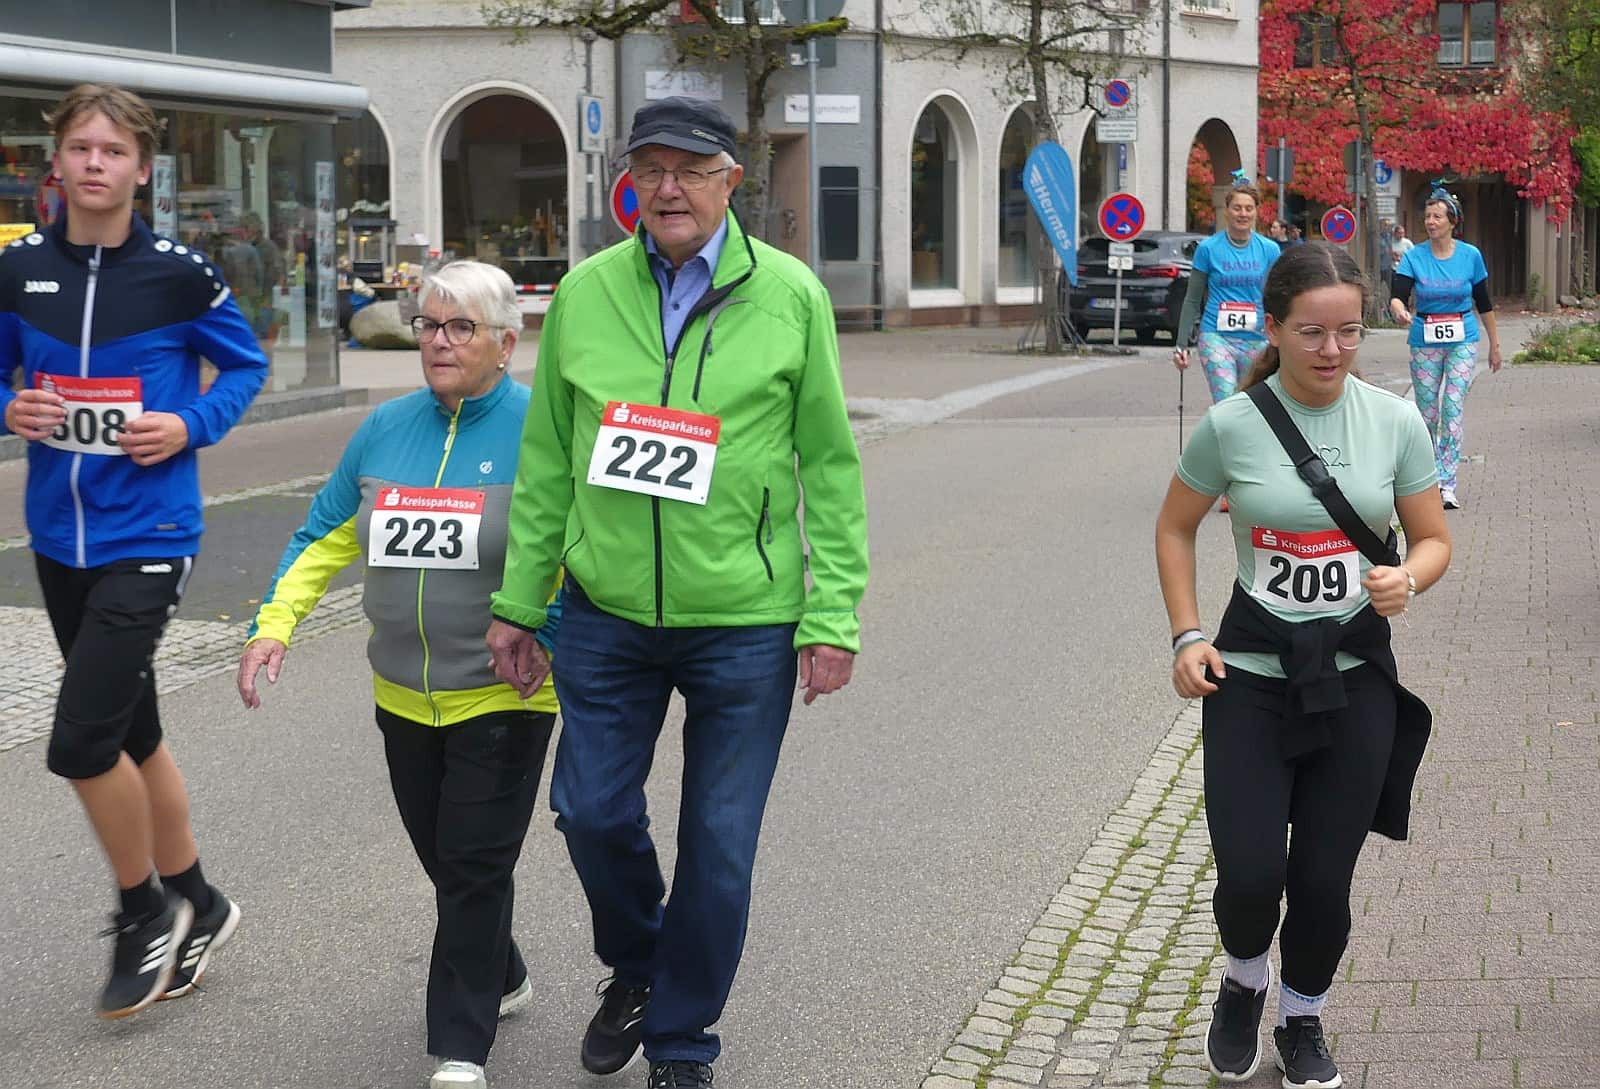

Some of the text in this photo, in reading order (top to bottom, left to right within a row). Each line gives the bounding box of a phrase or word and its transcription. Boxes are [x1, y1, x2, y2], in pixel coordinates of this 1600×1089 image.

[1034, 184, 1072, 251] Hermes
[1227, 313, 1247, 328] 64
[1434, 324, 1454, 340] 65
[631, 413, 713, 438] Kreissparkasse
[604, 435, 698, 490] 222
[401, 495, 477, 510] Kreissparkasse
[384, 517, 464, 560] 223
[1266, 555, 1348, 603] 209
